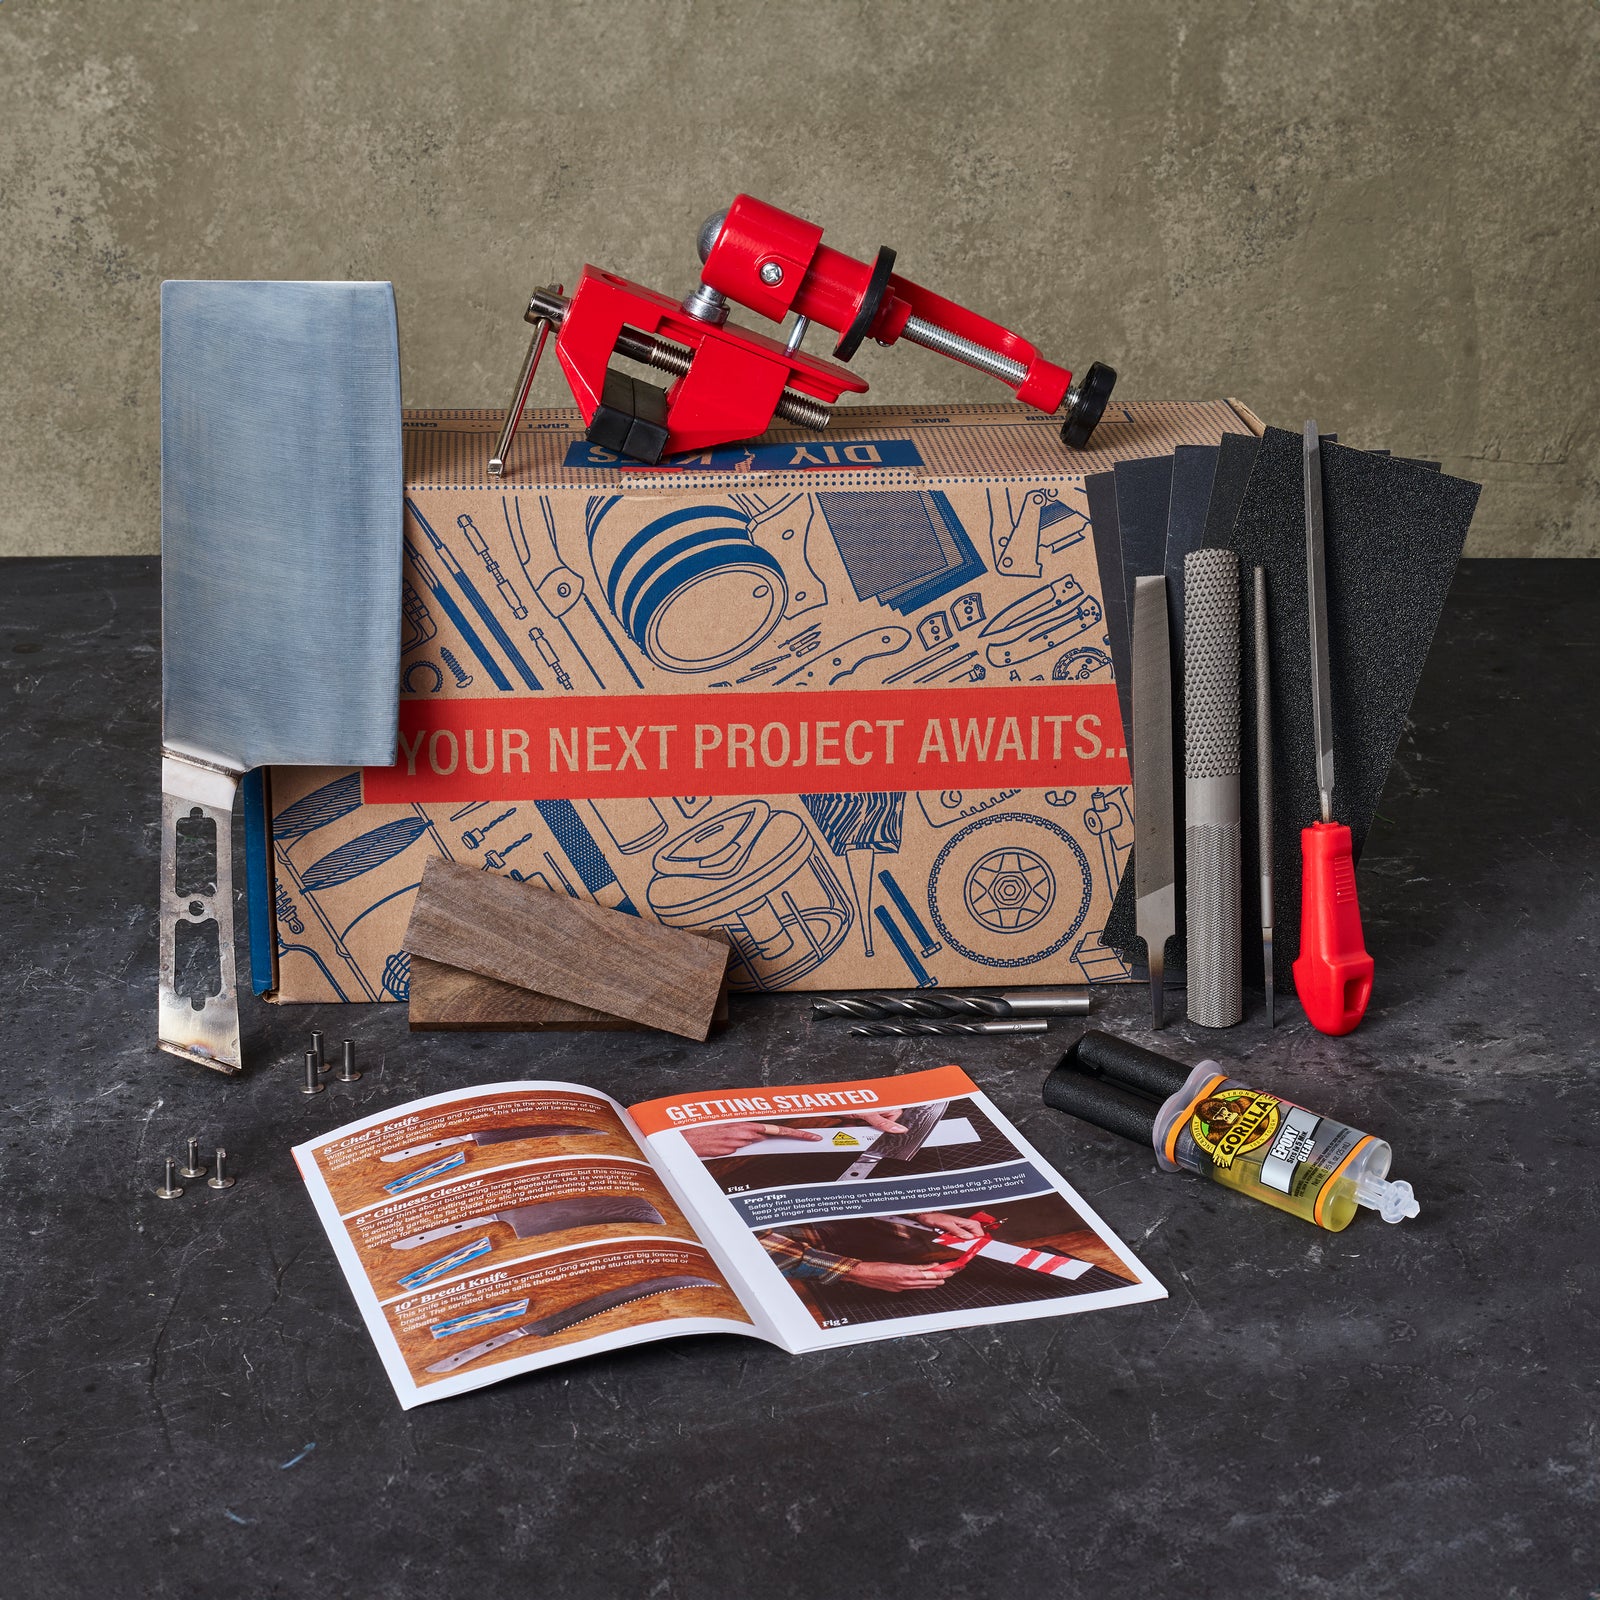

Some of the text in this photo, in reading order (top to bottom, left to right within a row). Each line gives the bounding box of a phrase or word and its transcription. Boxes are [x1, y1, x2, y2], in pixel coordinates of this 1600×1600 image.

[789, 444, 883, 464] DIY
[400, 728, 530, 776] YOUR
[549, 724, 678, 772] NEXT
[694, 719, 904, 768] PROJECT
[665, 1089, 879, 1121] GETTING STARTED
[674, 1117, 696, 1125] Laying
[327, 1151, 344, 1160] With
[354, 1138, 380, 1150] curved
[384, 1130, 404, 1143] blade
[420, 1117, 444, 1130] slicing
[447, 1112, 462, 1120] and
[340, 1128, 381, 1148] Chef's
[383, 1116, 420, 1132] Knife
[1220, 1101, 1273, 1155] GORILLA
[332, 1161, 350, 1171] used
[352, 1152, 372, 1163] knife
[383, 1143, 400, 1152] your
[1298, 1138, 1316, 1163] CLEAR
[360, 1224, 374, 1232] You
[377, 1217, 394, 1227] may
[397, 1209, 416, 1219] think
[419, 1202, 442, 1211] about
[445, 1188, 488, 1203] butchering
[491, 1182, 511, 1190] large
[514, 1177, 536, 1186] pieces
[374, 1195, 428, 1217] Chinese
[431, 1180, 483, 1199] Cleaver
[748, 1202, 773, 1210] Safety
[796, 1196, 820, 1204] Before
[752, 1208, 772, 1216] keep
[782, 1210, 804, 1218] finger
[365, 1227, 404, 1243] smashing
[446, 1208, 458, 1216] flat
[460, 1202, 483, 1211] blade
[499, 1190, 525, 1201] slicing
[399, 1311, 415, 1319] This
[418, 1303, 438, 1312] knife
[476, 1285, 493, 1294] and
[495, 1279, 519, 1289] that's
[521, 1272, 542, 1283] great
[559, 1264, 577, 1272] long
[580, 1259, 600, 1267] even
[421, 1281, 465, 1303] Bread
[469, 1272, 508, 1288] Knife
[430, 1307, 447, 1315] The
[448, 1294, 483, 1310] serrated
[486, 1288, 509, 1298] blade
[512, 1282, 531, 1291] sails
[533, 1273, 566, 1286] through
[569, 1268, 590, 1277] even
[608, 1259, 644, 1268] sturdiest
